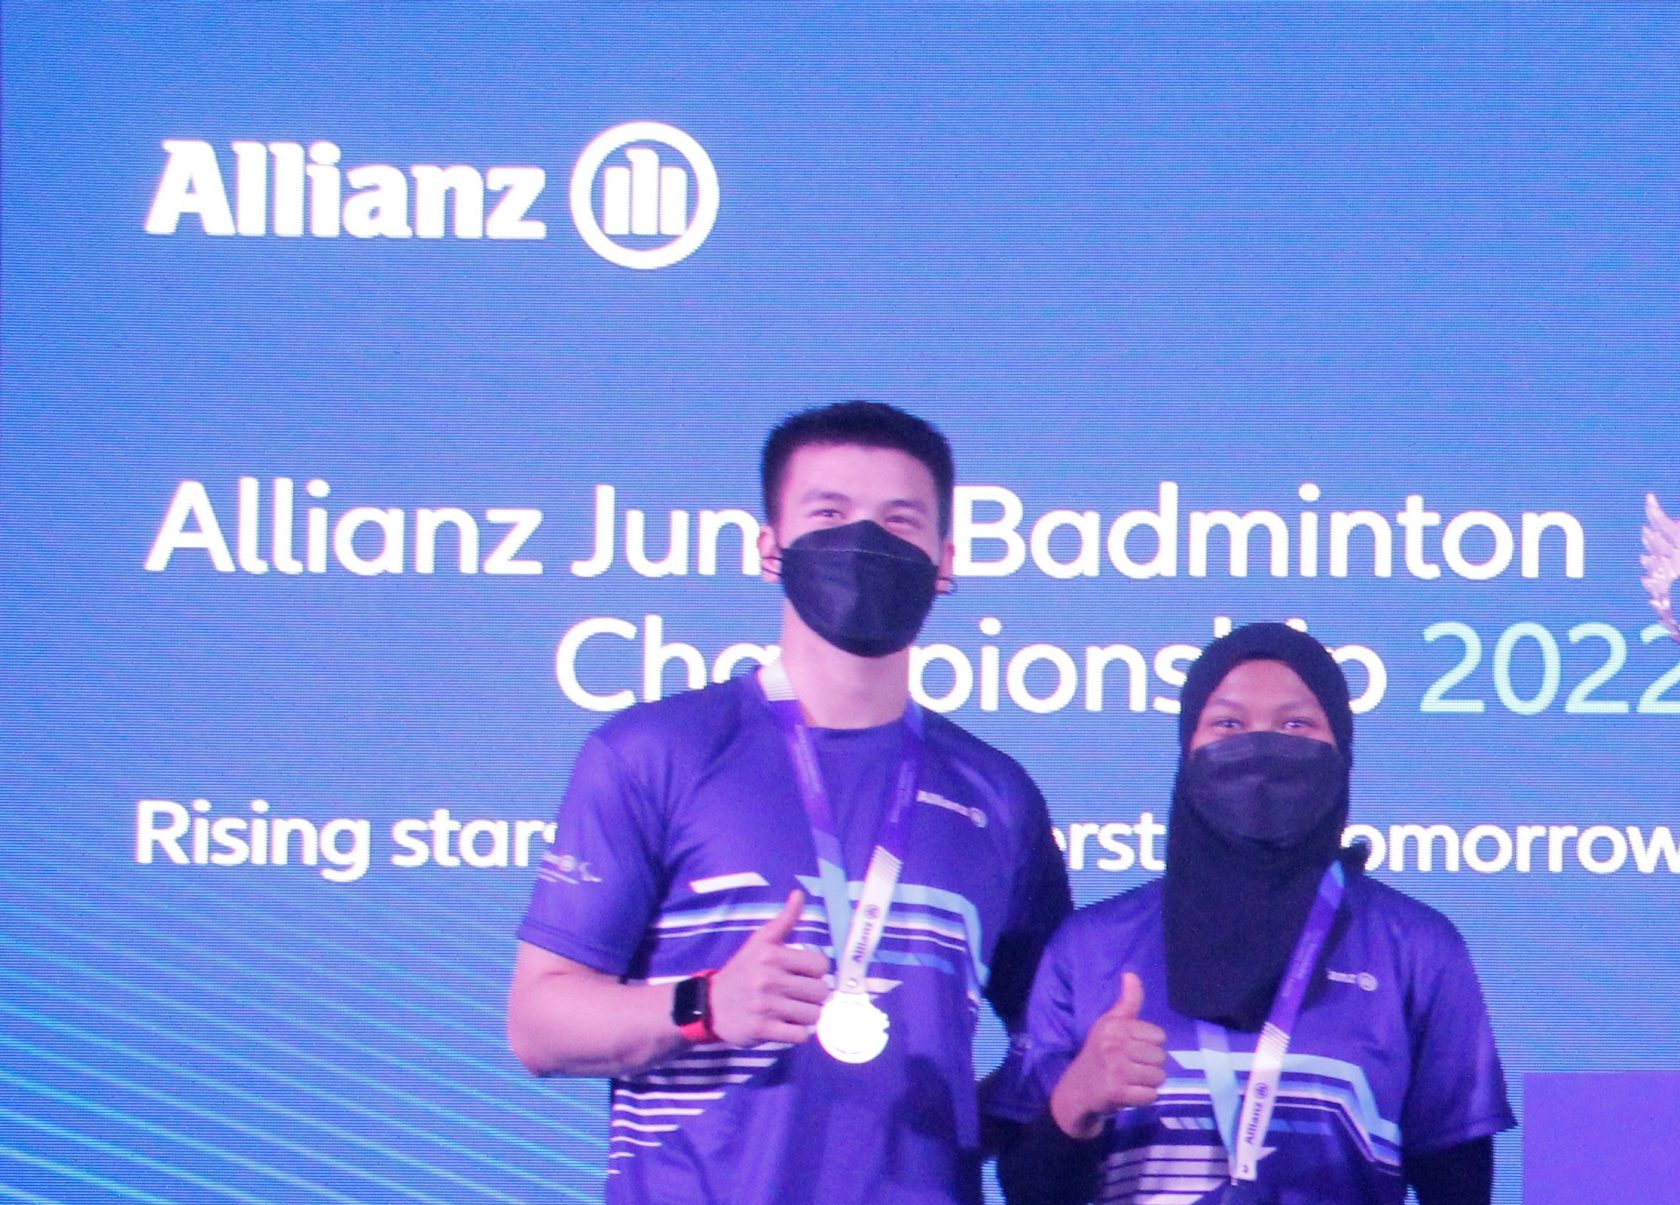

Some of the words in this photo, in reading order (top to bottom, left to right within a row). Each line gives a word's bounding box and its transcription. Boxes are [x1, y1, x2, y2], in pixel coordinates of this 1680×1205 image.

[145, 140, 547, 240] Allianz
[144, 476, 544, 578] Allianz
[570, 484, 762, 578] Jun
[951, 480, 1585, 579] Badminton
[556, 614, 1388, 714] Chpions
[135, 798, 371, 883] Rising
[392, 808, 557, 868] star
[852, 922, 872, 963] Allianz
[1245, 1097, 1264, 1146] Allianz
